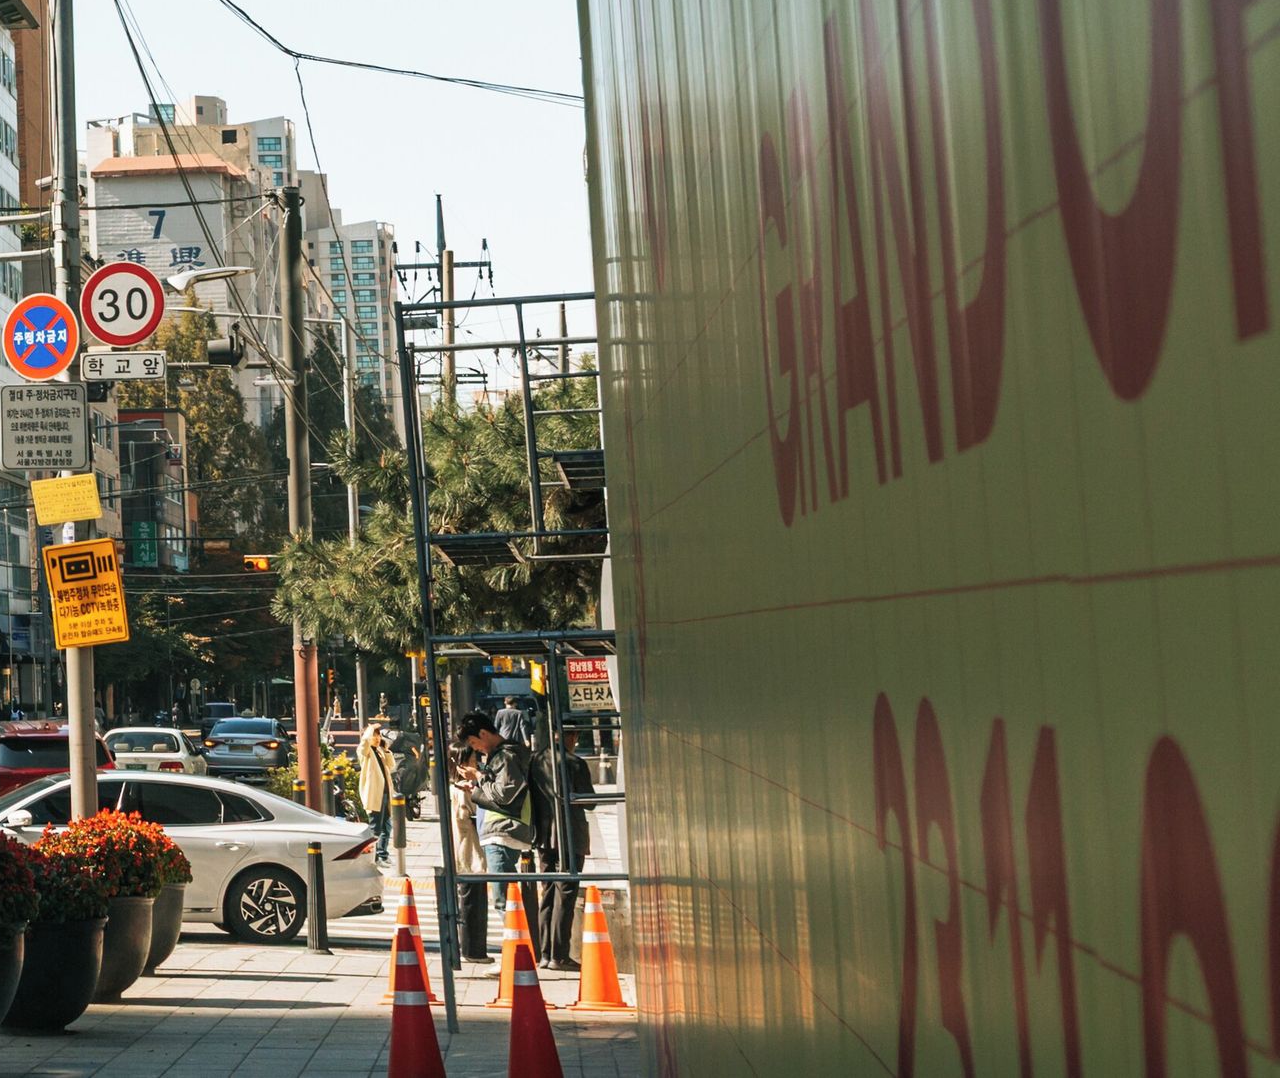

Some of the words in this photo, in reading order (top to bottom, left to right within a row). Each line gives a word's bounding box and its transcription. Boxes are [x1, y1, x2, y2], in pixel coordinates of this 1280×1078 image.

[148, 209, 166, 239] 7
[97, 287, 148, 323] 30
[13, 327, 68, 346] 주정차금지
[8, 389, 24, 402] 절대
[56, 585, 90, 604] 불법주정차
[90, 582, 118, 598] 무인단속
[59, 604, 80, 619] 다기능
